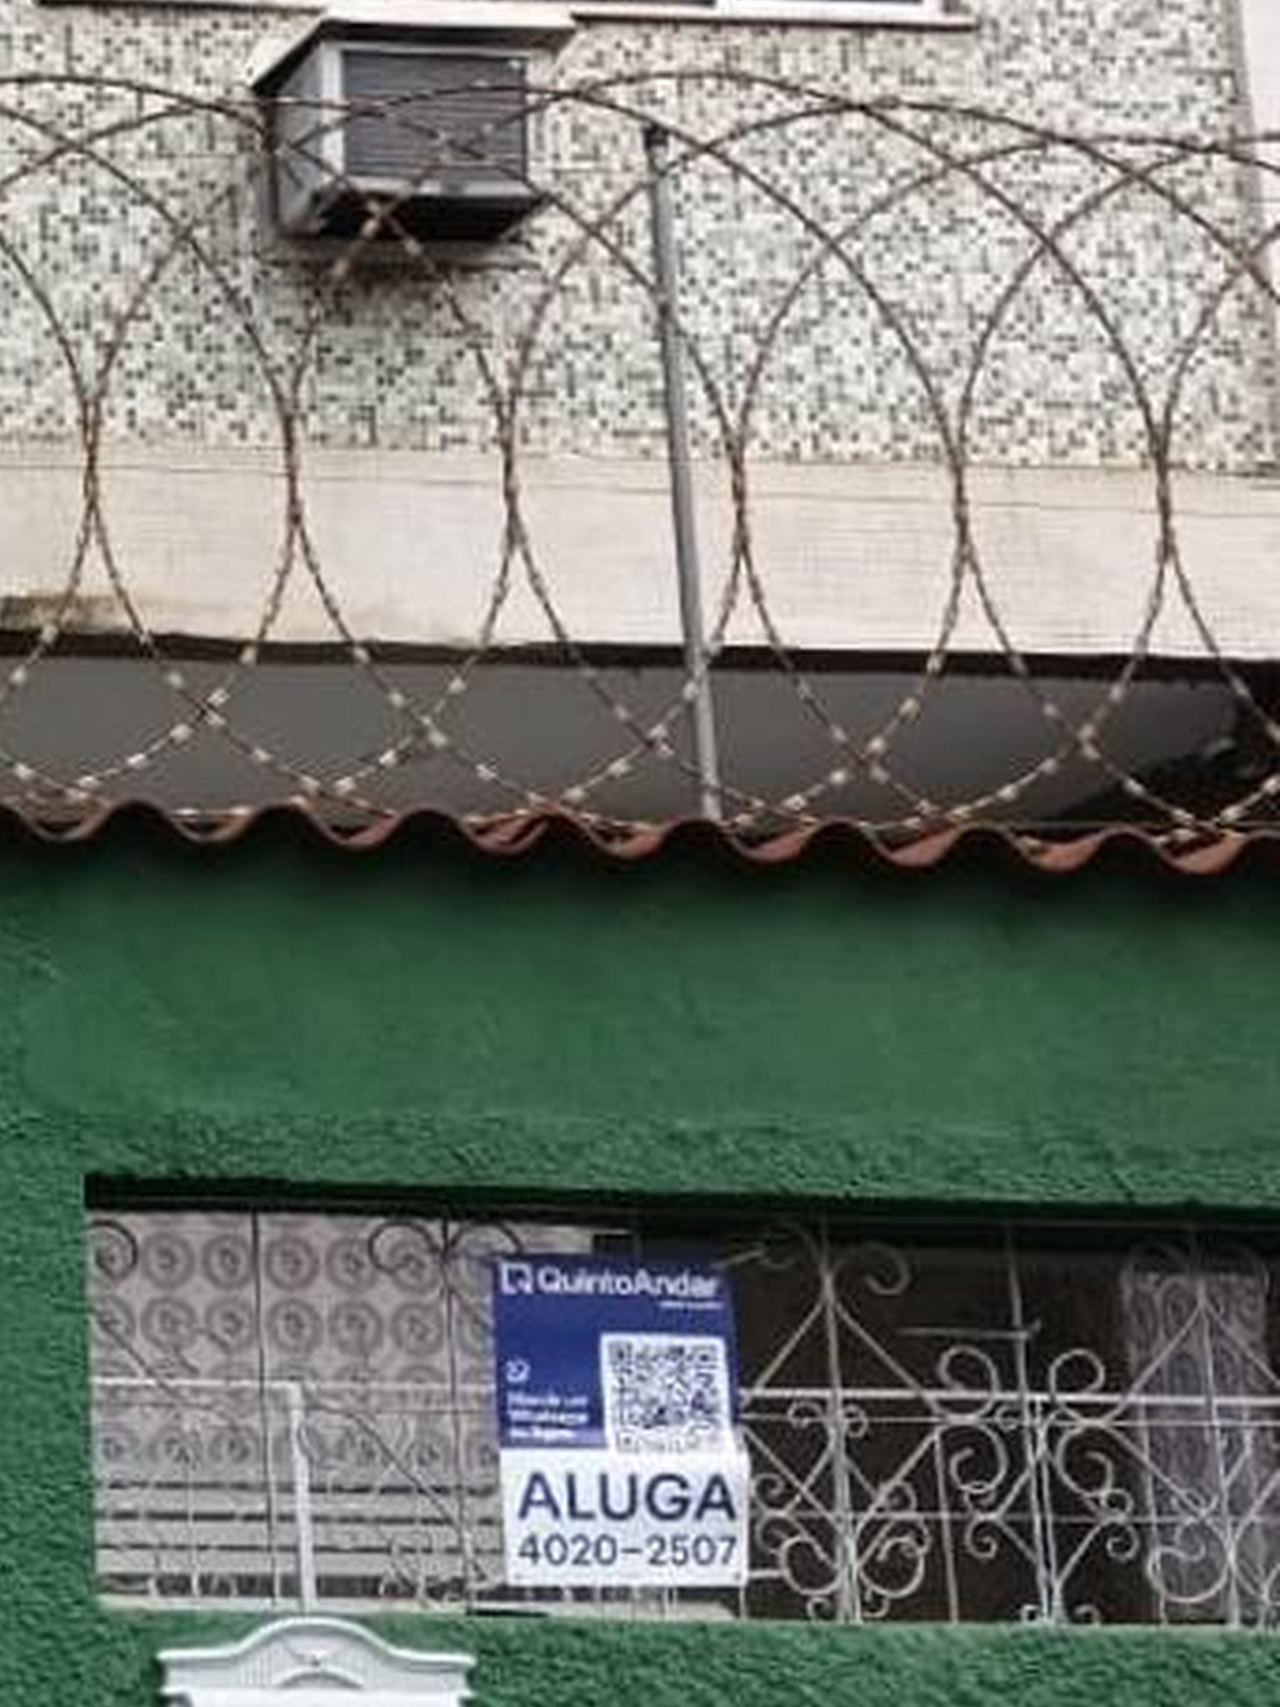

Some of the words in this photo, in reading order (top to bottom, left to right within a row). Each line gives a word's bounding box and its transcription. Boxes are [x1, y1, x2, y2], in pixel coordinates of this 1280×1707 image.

[538, 1267, 718, 1296] QuintoAndar
[519, 1473, 737, 1520] ALUGA
[518, 1534, 737, 1566] 4020-2507
